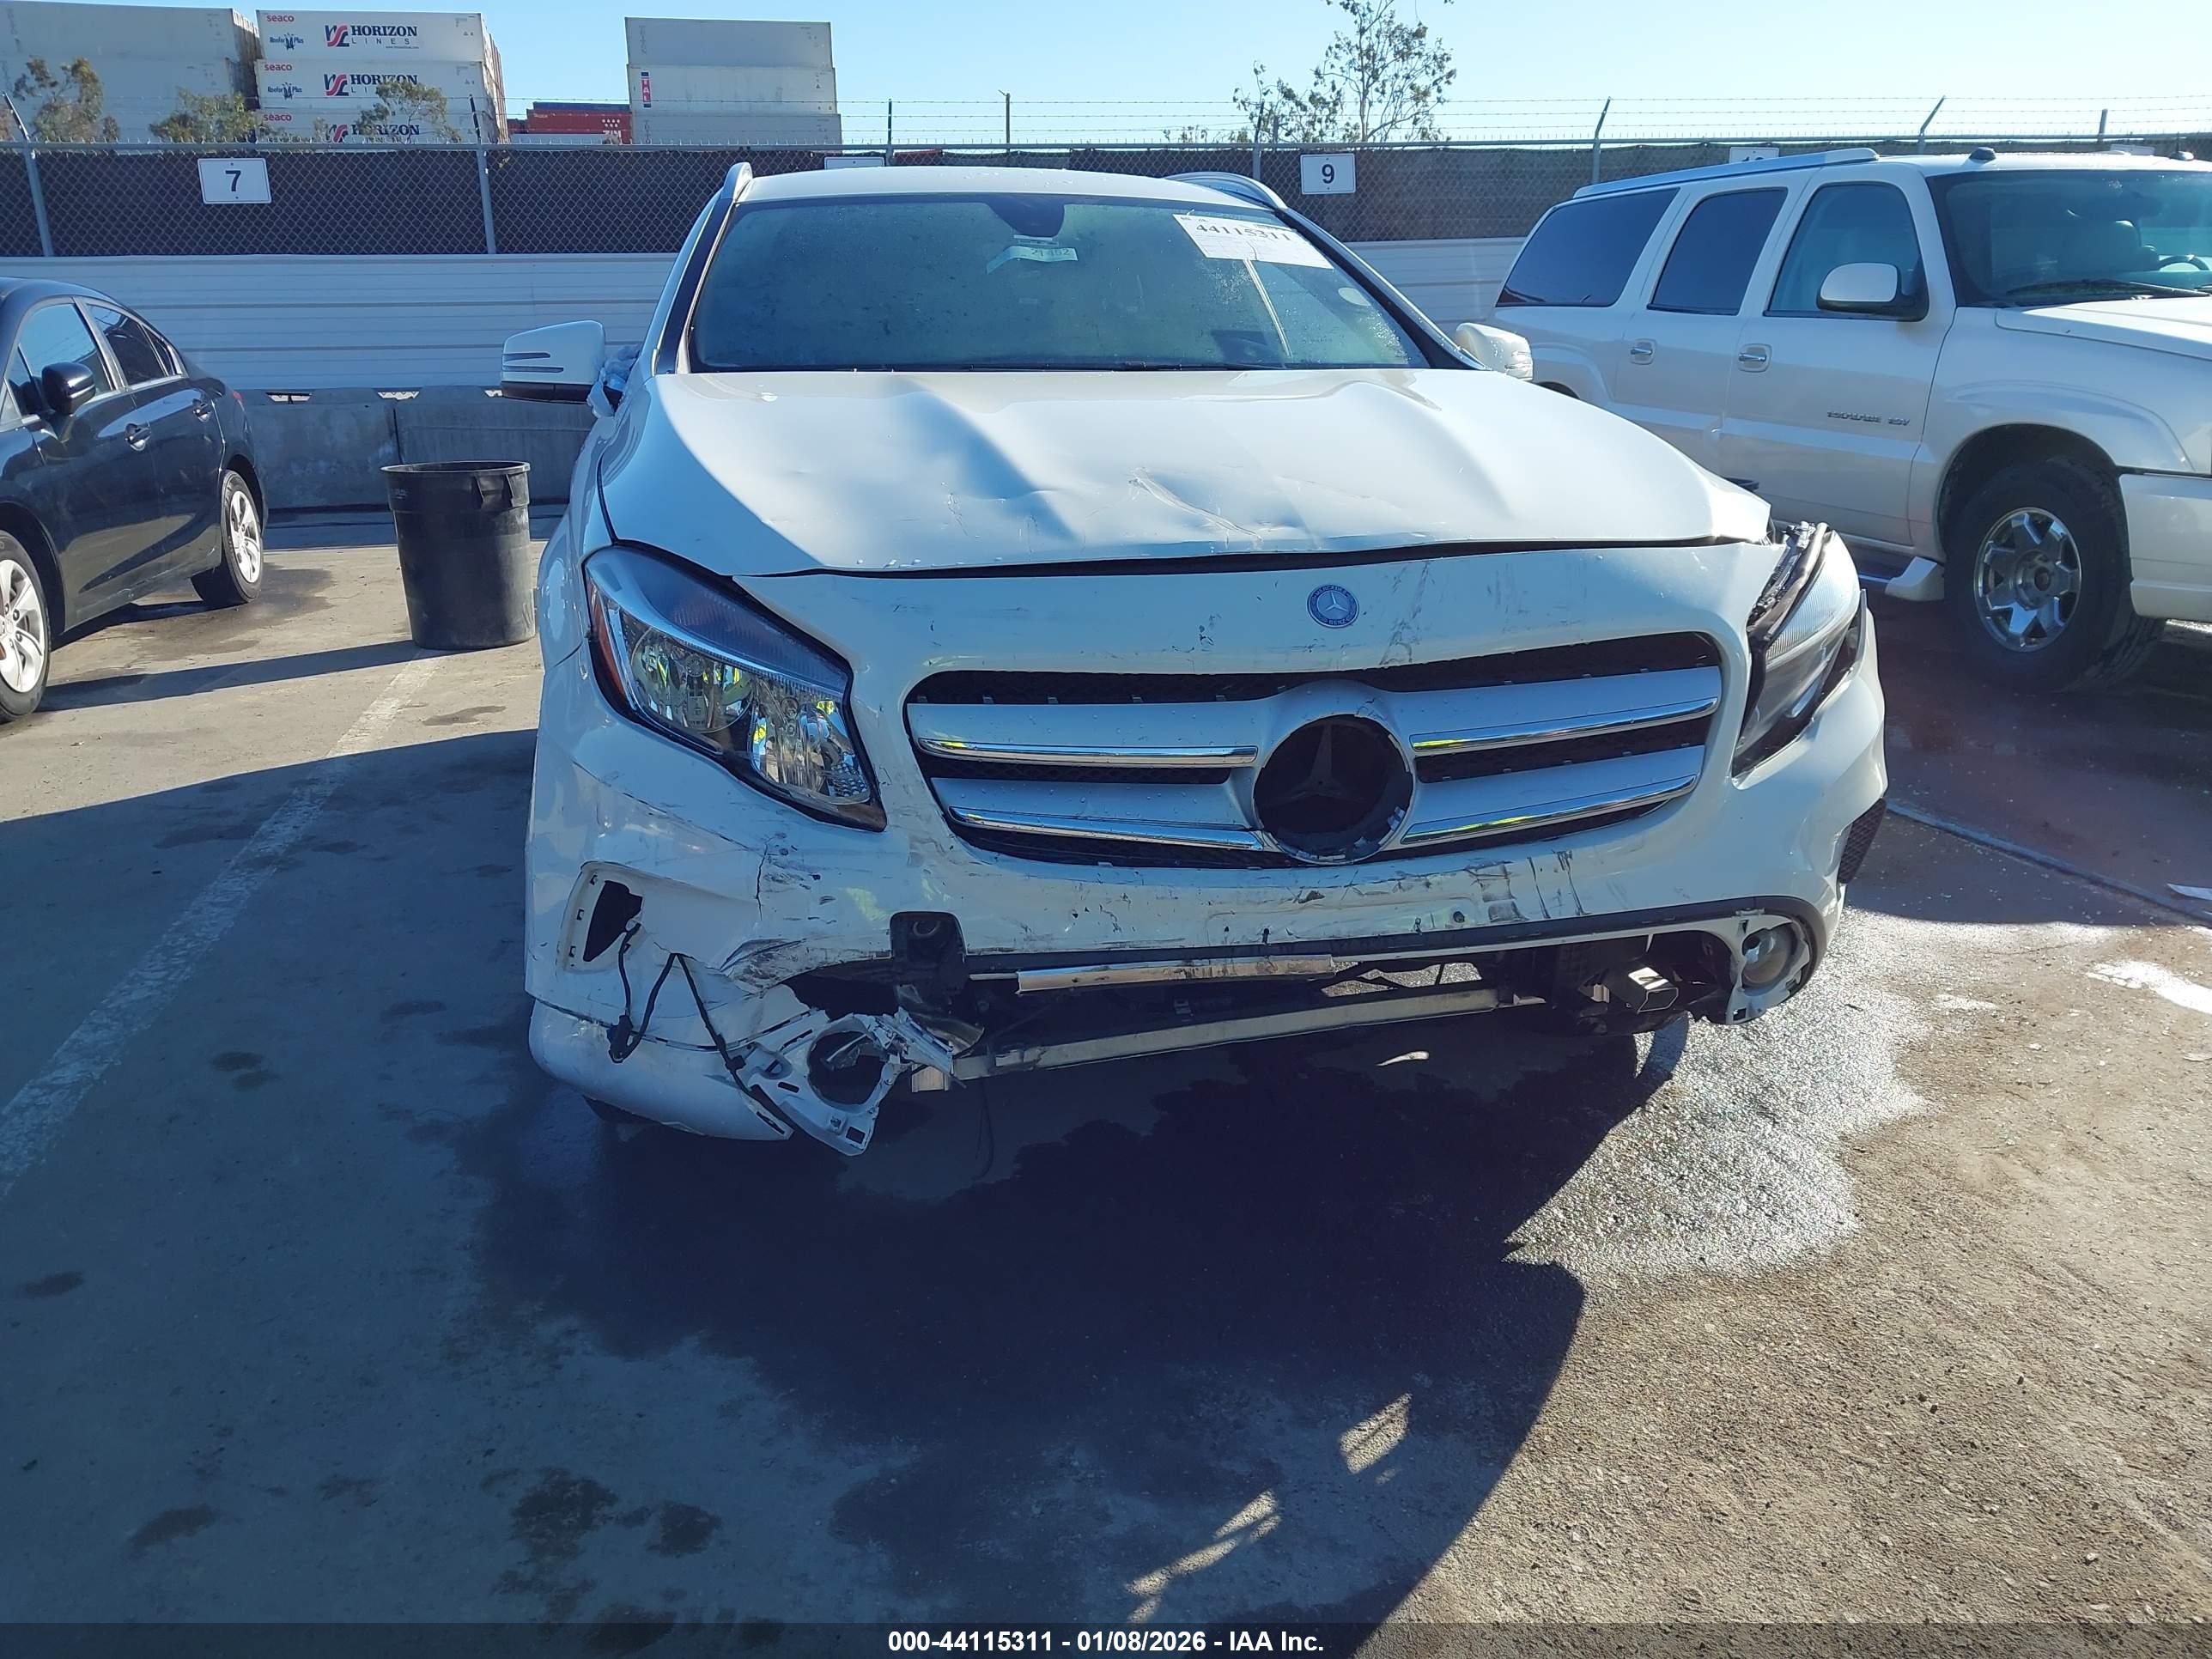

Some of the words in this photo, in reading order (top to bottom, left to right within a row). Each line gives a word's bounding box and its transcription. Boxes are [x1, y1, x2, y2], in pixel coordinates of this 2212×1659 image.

[350, 25, 418, 36] HORIZON
[225, 170, 241, 191] 7
[1322, 163, 1335, 184] 9
[1195, 224, 1291, 241] 44115311
